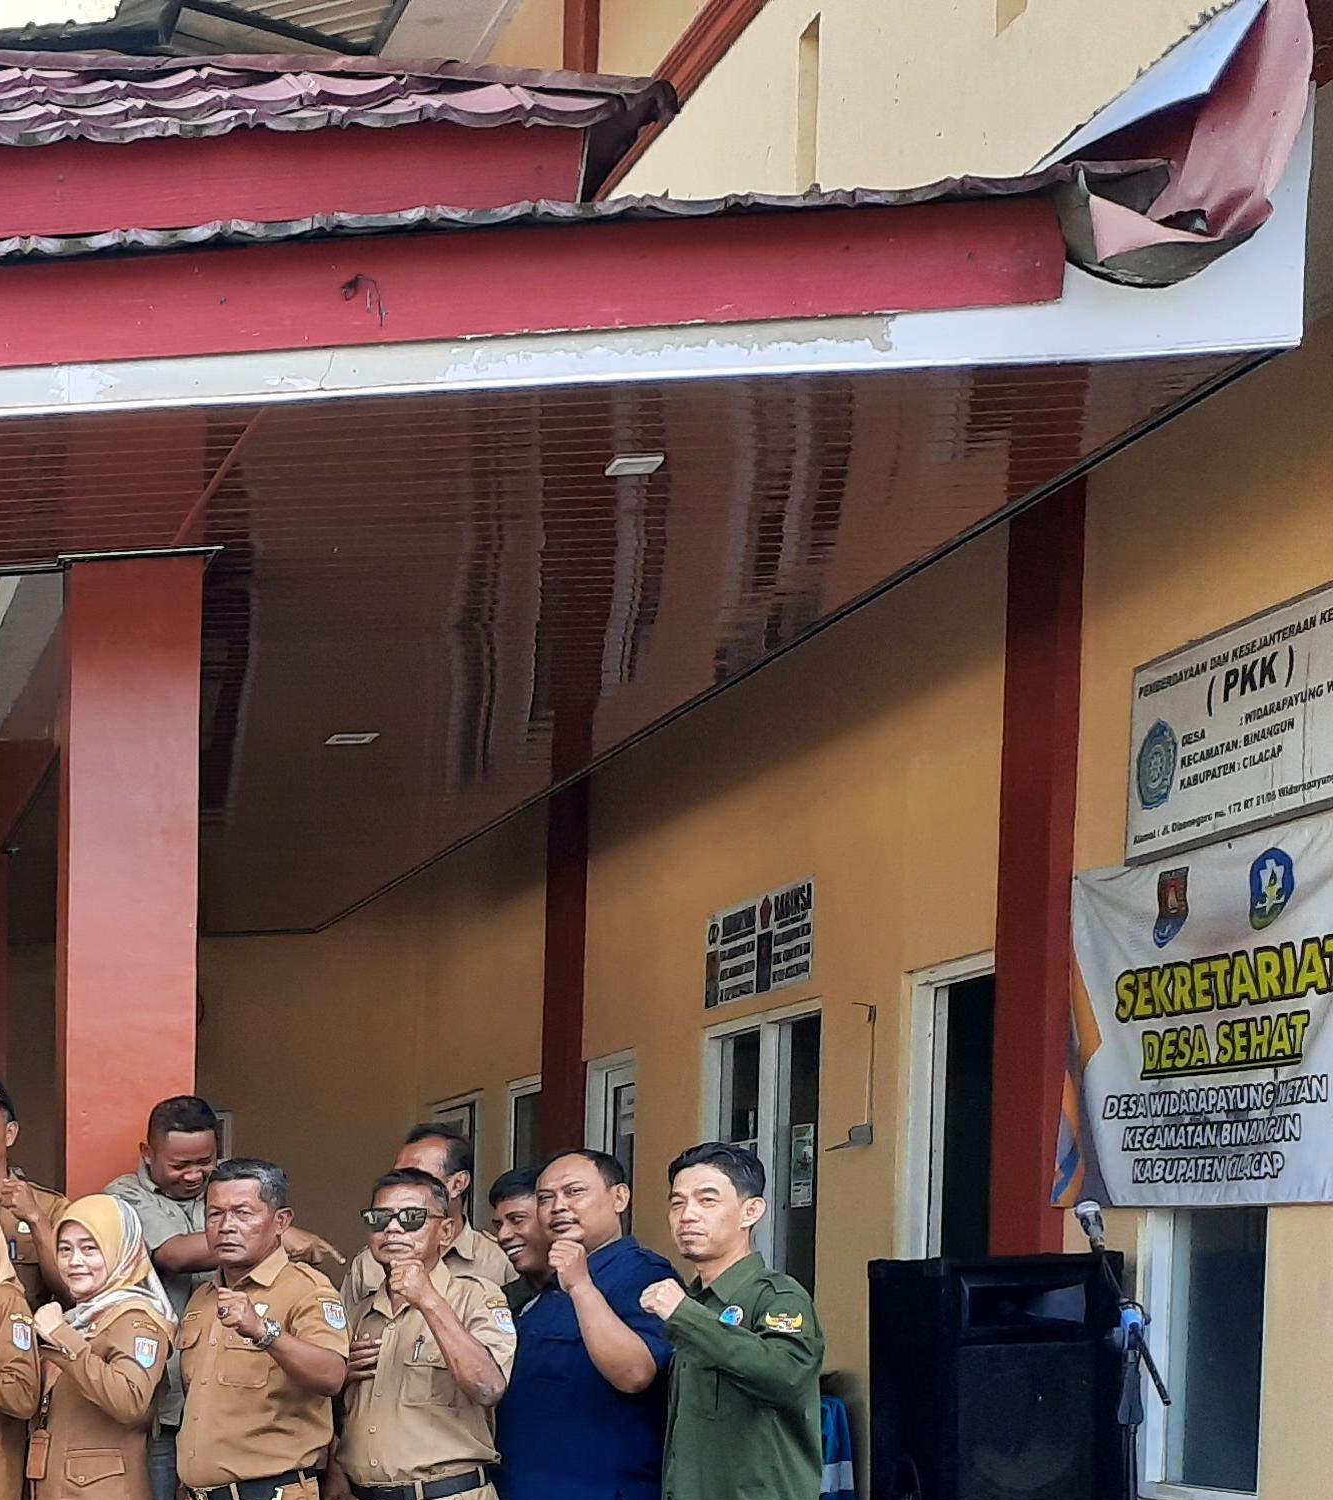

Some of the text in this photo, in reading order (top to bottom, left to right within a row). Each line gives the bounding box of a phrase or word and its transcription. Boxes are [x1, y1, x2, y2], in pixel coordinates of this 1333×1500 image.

[1210, 652, 1229, 671] DAN
[1223, 651, 1278, 703] PKK
[1181, 728, 1206, 747] DESA
[1244, 680, 1323, 725] WIDARAPAYUNG
[1243, 718, 1295, 747] BINANGUN
[1242, 744, 1283, 769] CILACAP
[1243, 797, 1254, 811] RT
[1141, 1010, 1310, 1071] DESA SEHAT
[1103, 1093, 1150, 1120] DESA
[1150, 1081, 1275, 1117] WIDARAPAYUNG
[1122, 1113, 1302, 1151] KECAMATAN BINANGUN
[1133, 1151, 1285, 1184] KABUPATEN CILACAP
